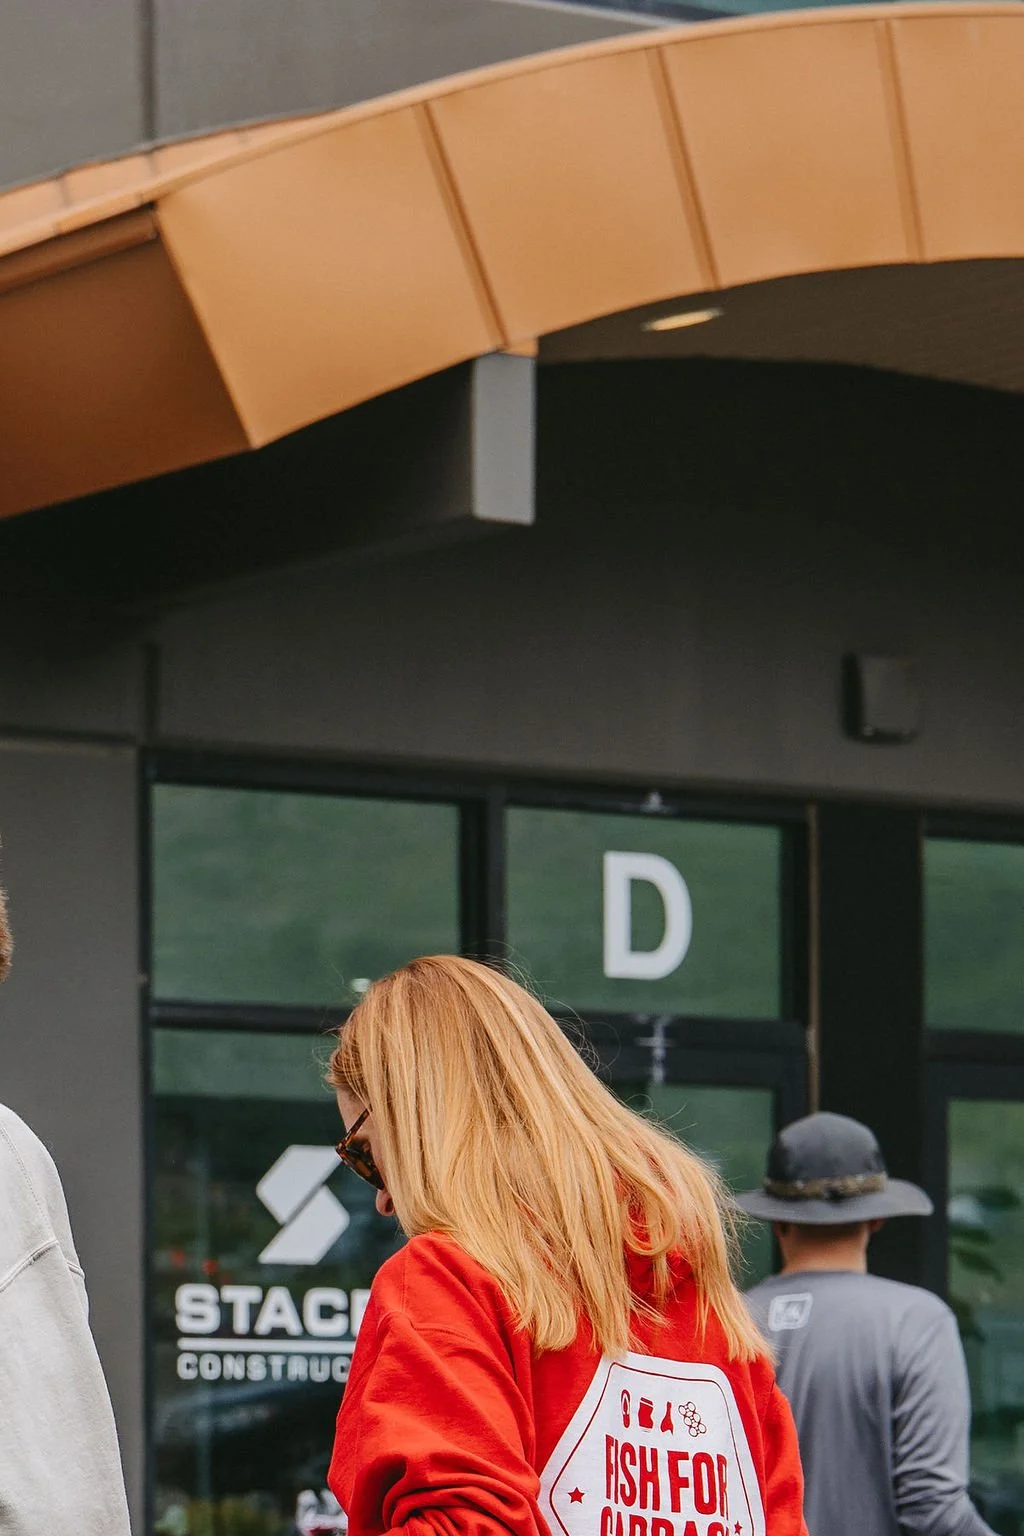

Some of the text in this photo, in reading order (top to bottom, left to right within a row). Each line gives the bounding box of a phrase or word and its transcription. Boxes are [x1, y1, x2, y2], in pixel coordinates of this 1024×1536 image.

[603, 850, 693, 980] D
[605, 1434, 729, 1520] FISH FOR
